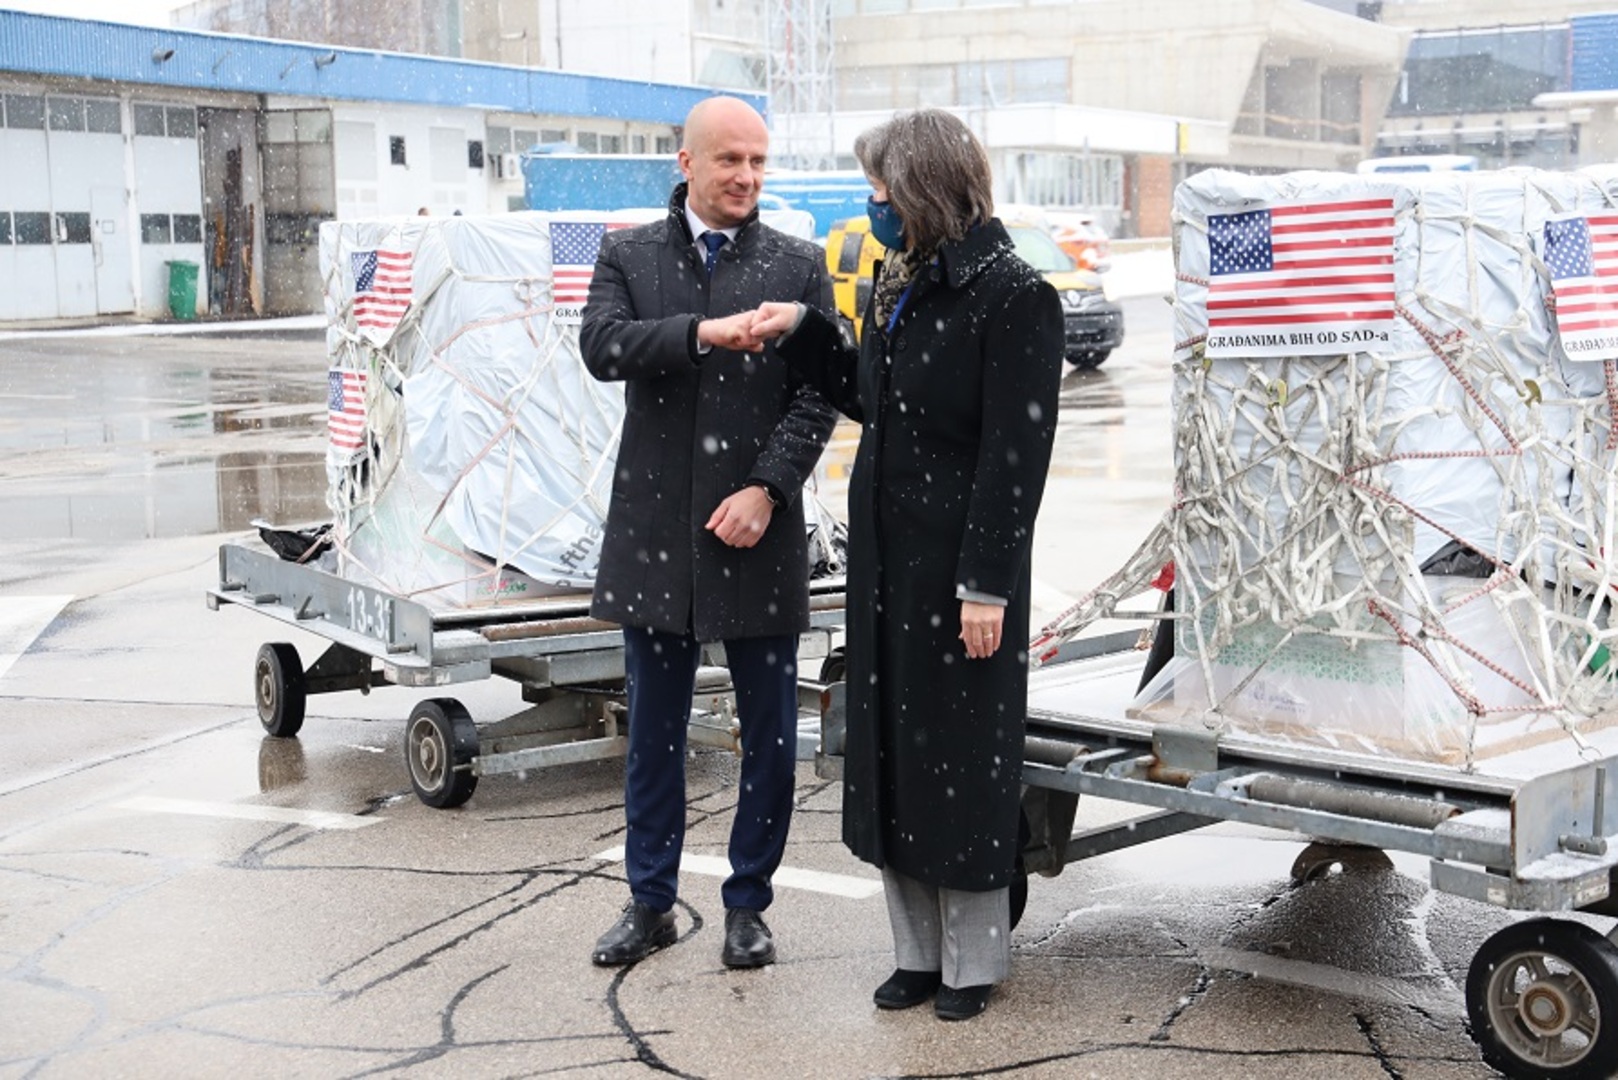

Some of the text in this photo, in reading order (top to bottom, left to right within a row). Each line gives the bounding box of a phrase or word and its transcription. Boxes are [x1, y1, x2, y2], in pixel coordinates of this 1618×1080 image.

[1290, 331, 1313, 346] BIH
[1317, 331, 1338, 344] OD
[1341, 328, 1389, 343] SAD-a
